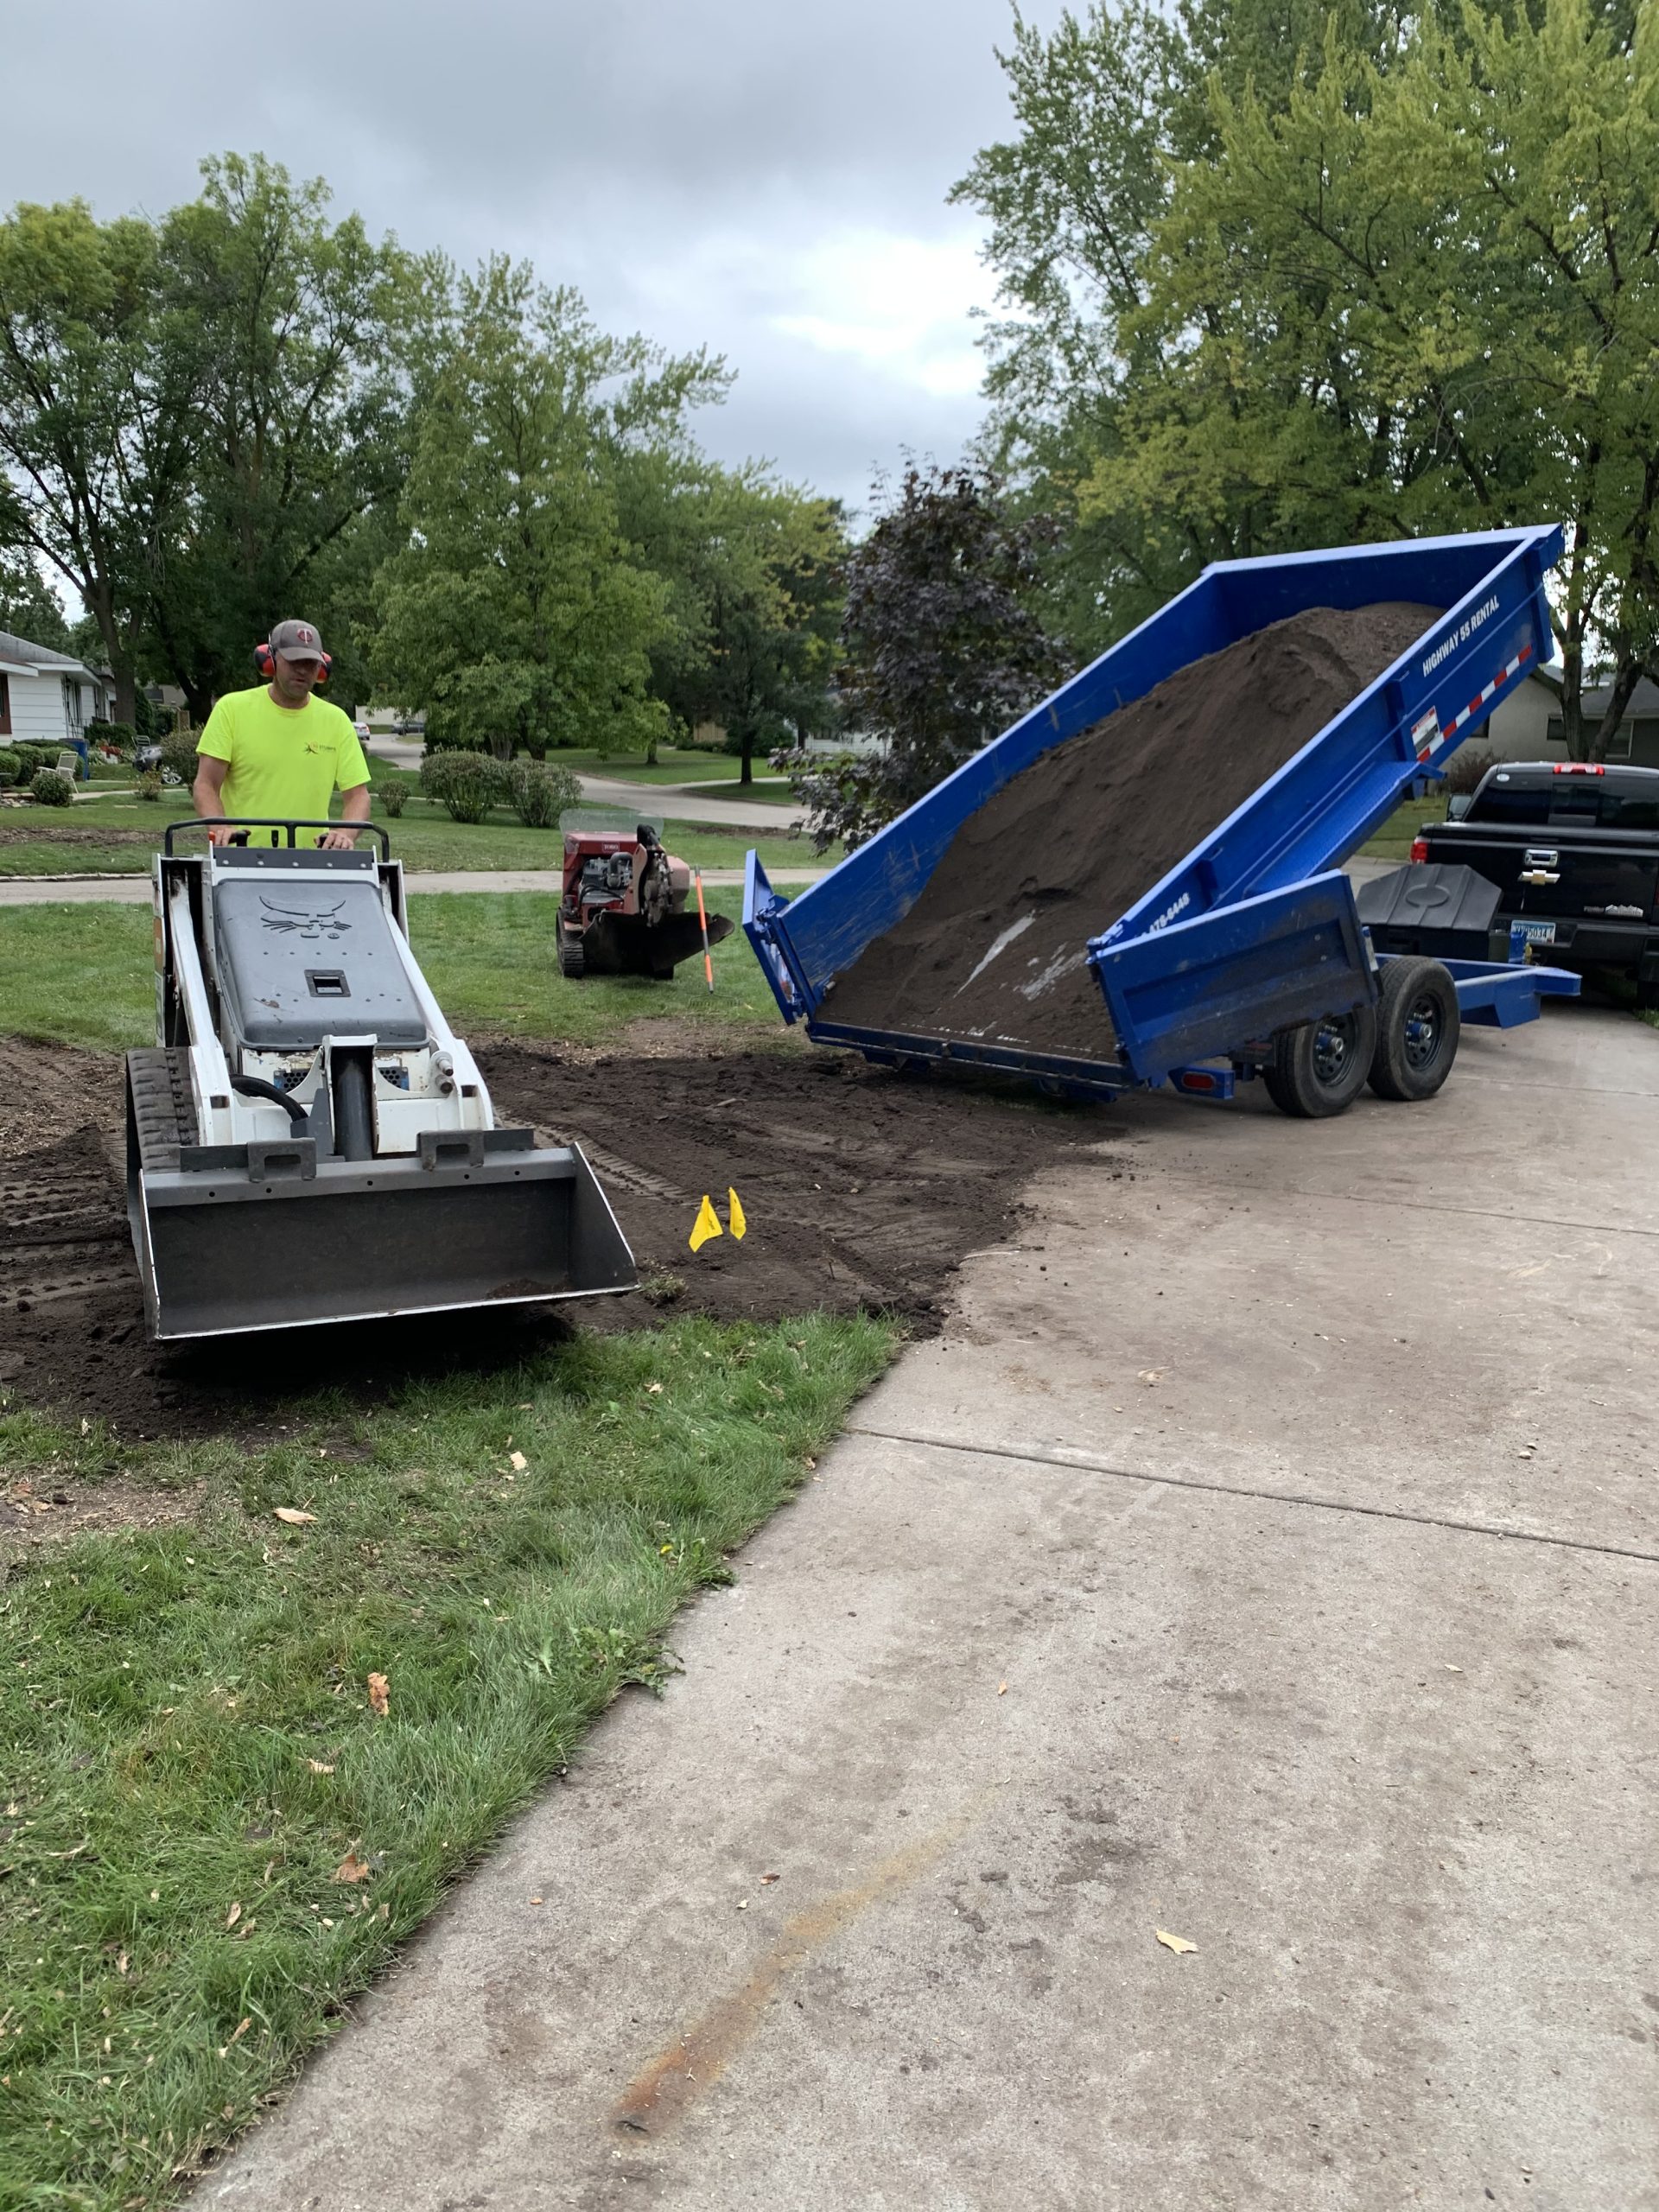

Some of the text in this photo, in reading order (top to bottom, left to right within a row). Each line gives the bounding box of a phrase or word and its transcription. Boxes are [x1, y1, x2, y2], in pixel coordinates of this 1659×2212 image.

[1422, 594, 1499, 677] HIGHWAY 55 RENTAL
